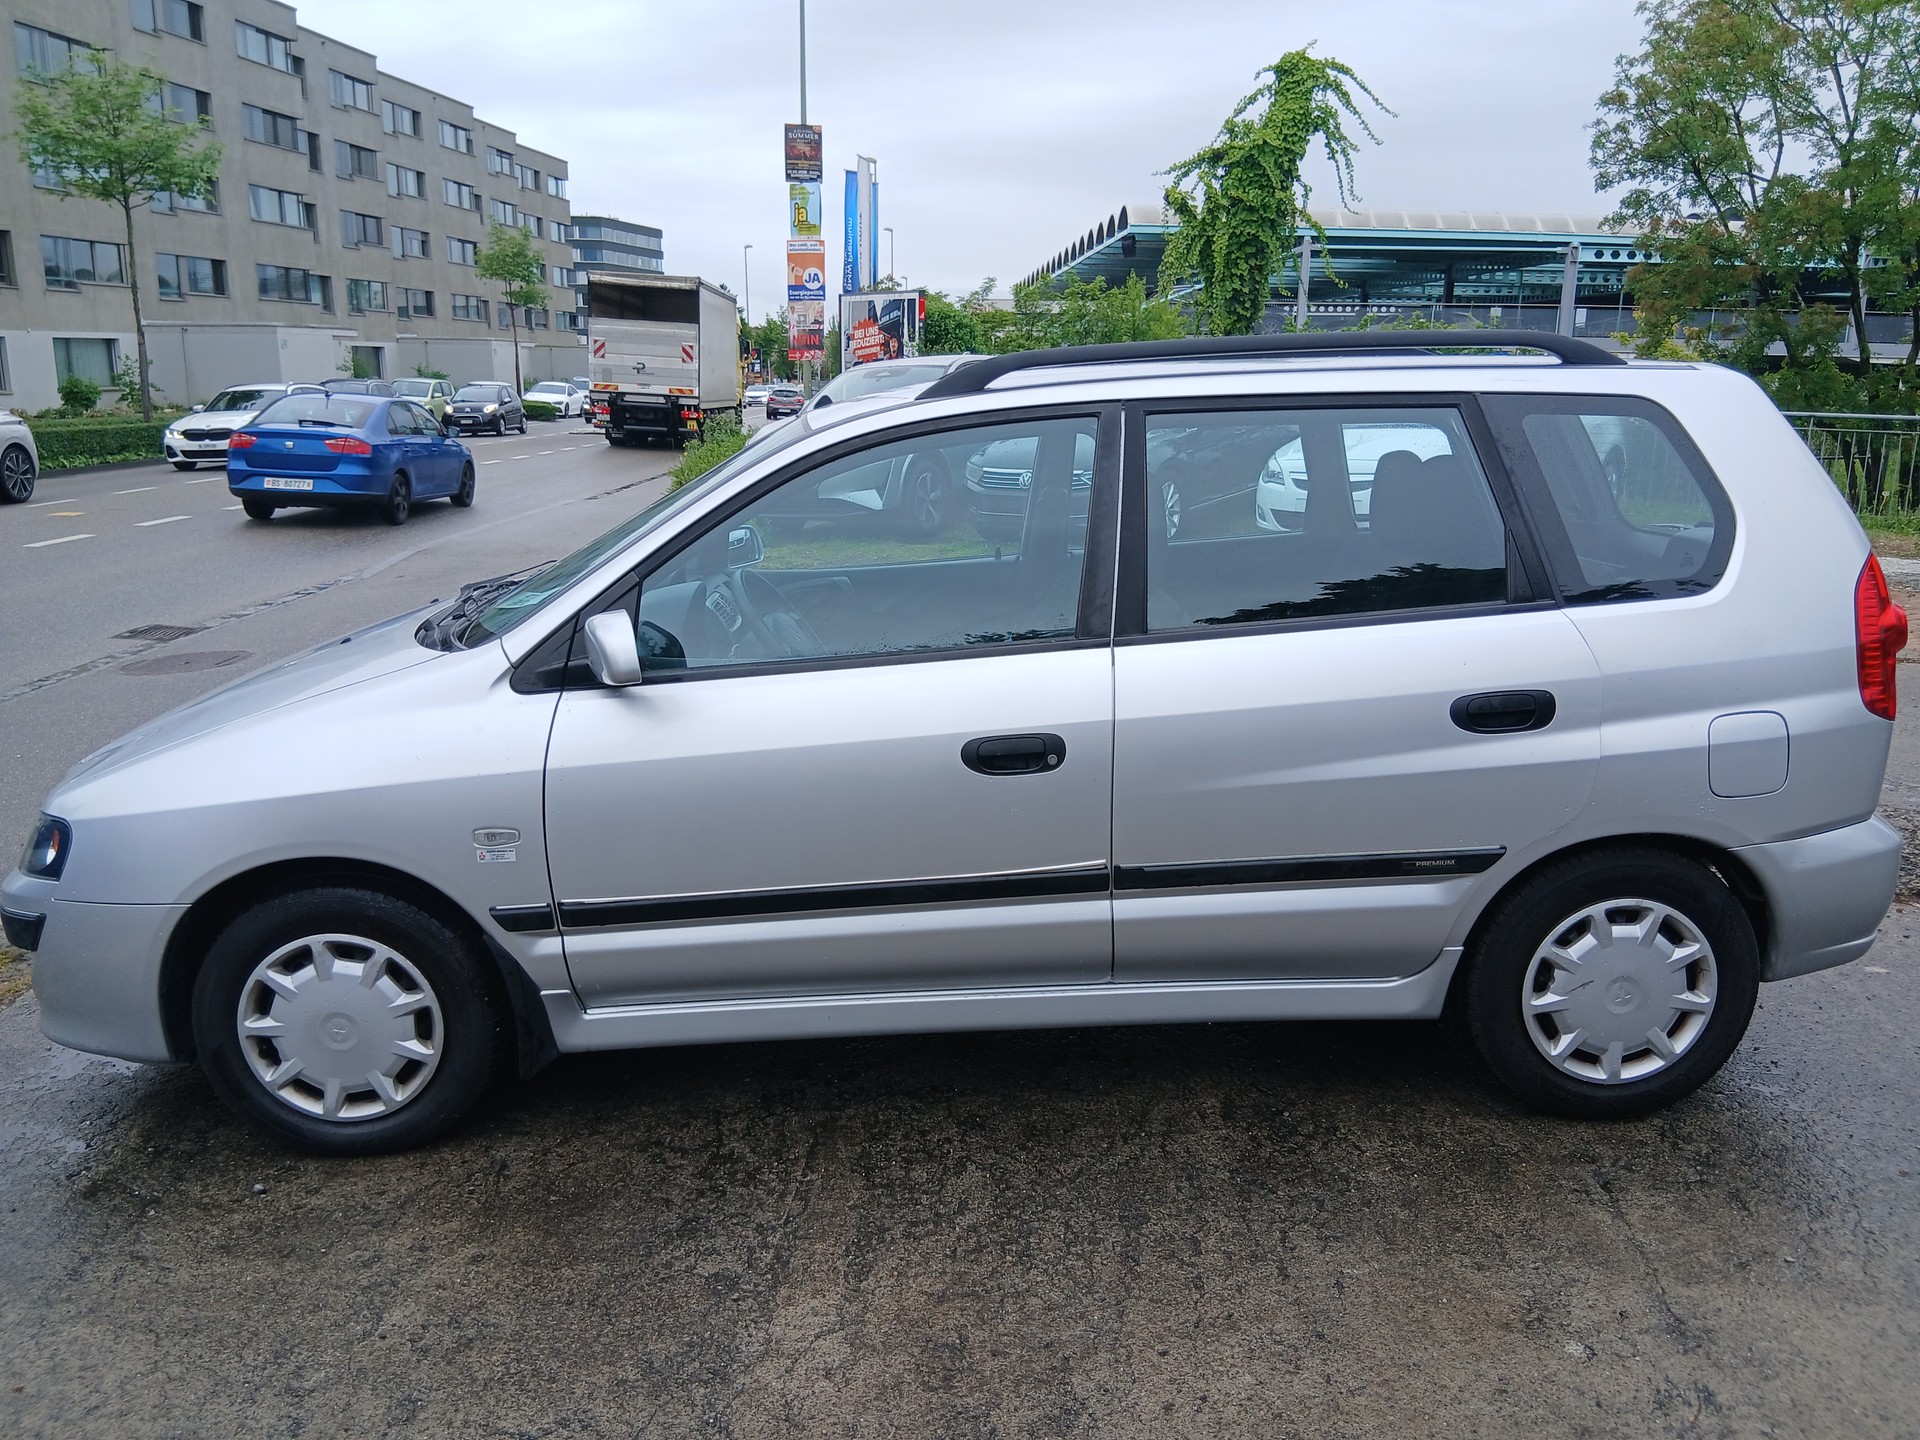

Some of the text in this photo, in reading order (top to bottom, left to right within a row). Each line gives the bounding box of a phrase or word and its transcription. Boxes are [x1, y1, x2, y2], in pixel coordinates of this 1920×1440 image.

[804, 273, 820, 284] JA
[854, 325, 879, 339] BEI UNS
